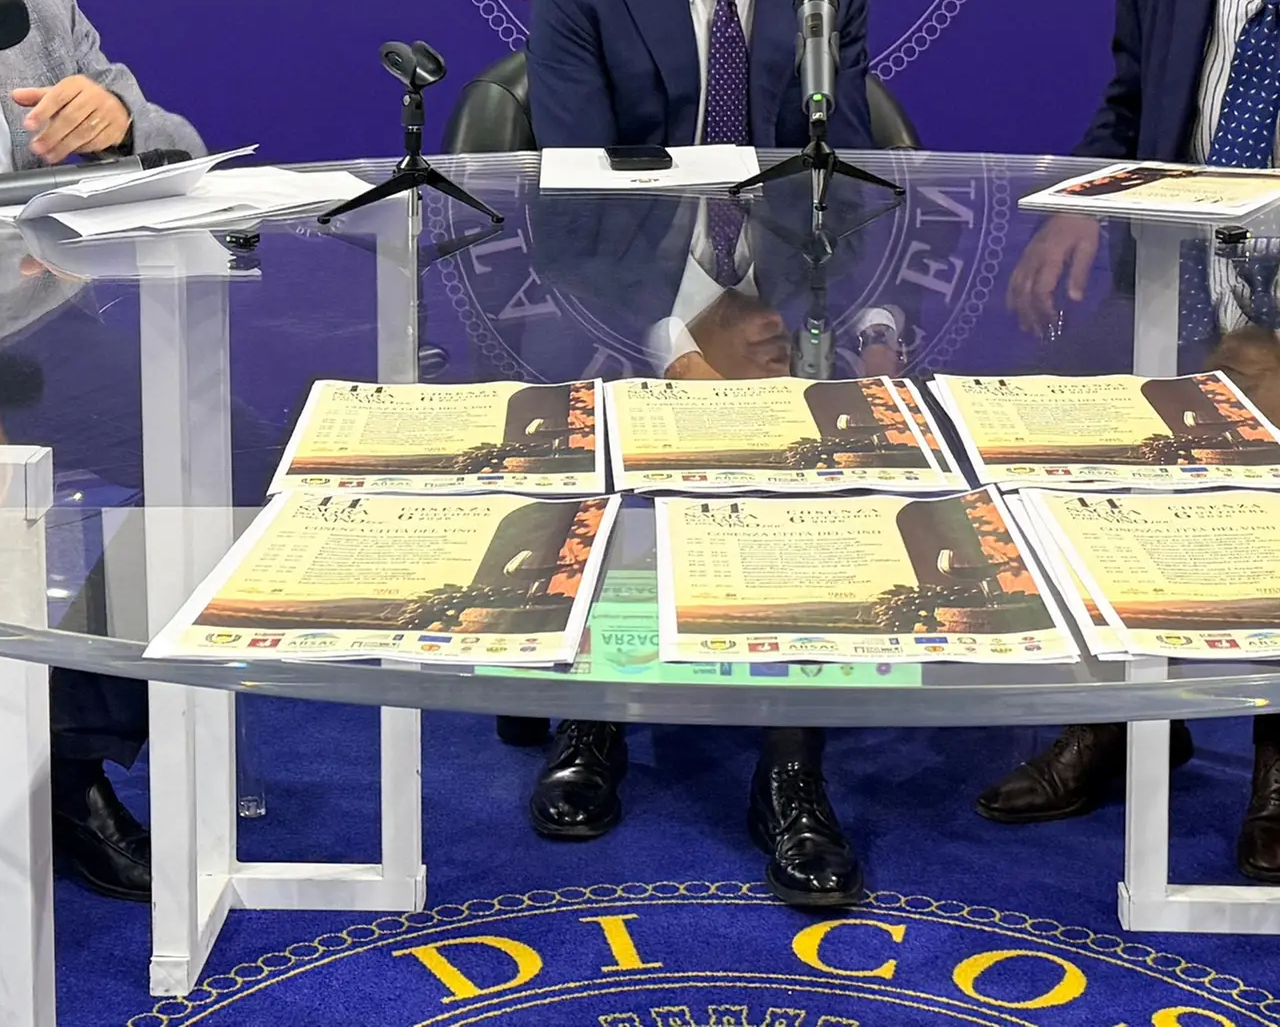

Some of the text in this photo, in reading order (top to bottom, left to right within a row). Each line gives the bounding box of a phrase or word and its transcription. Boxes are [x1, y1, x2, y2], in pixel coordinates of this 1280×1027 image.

[287, 638, 338, 648] ARSAC
[788, 643, 839, 652] ARSAC
[392, 913, 663, 1003] DI
